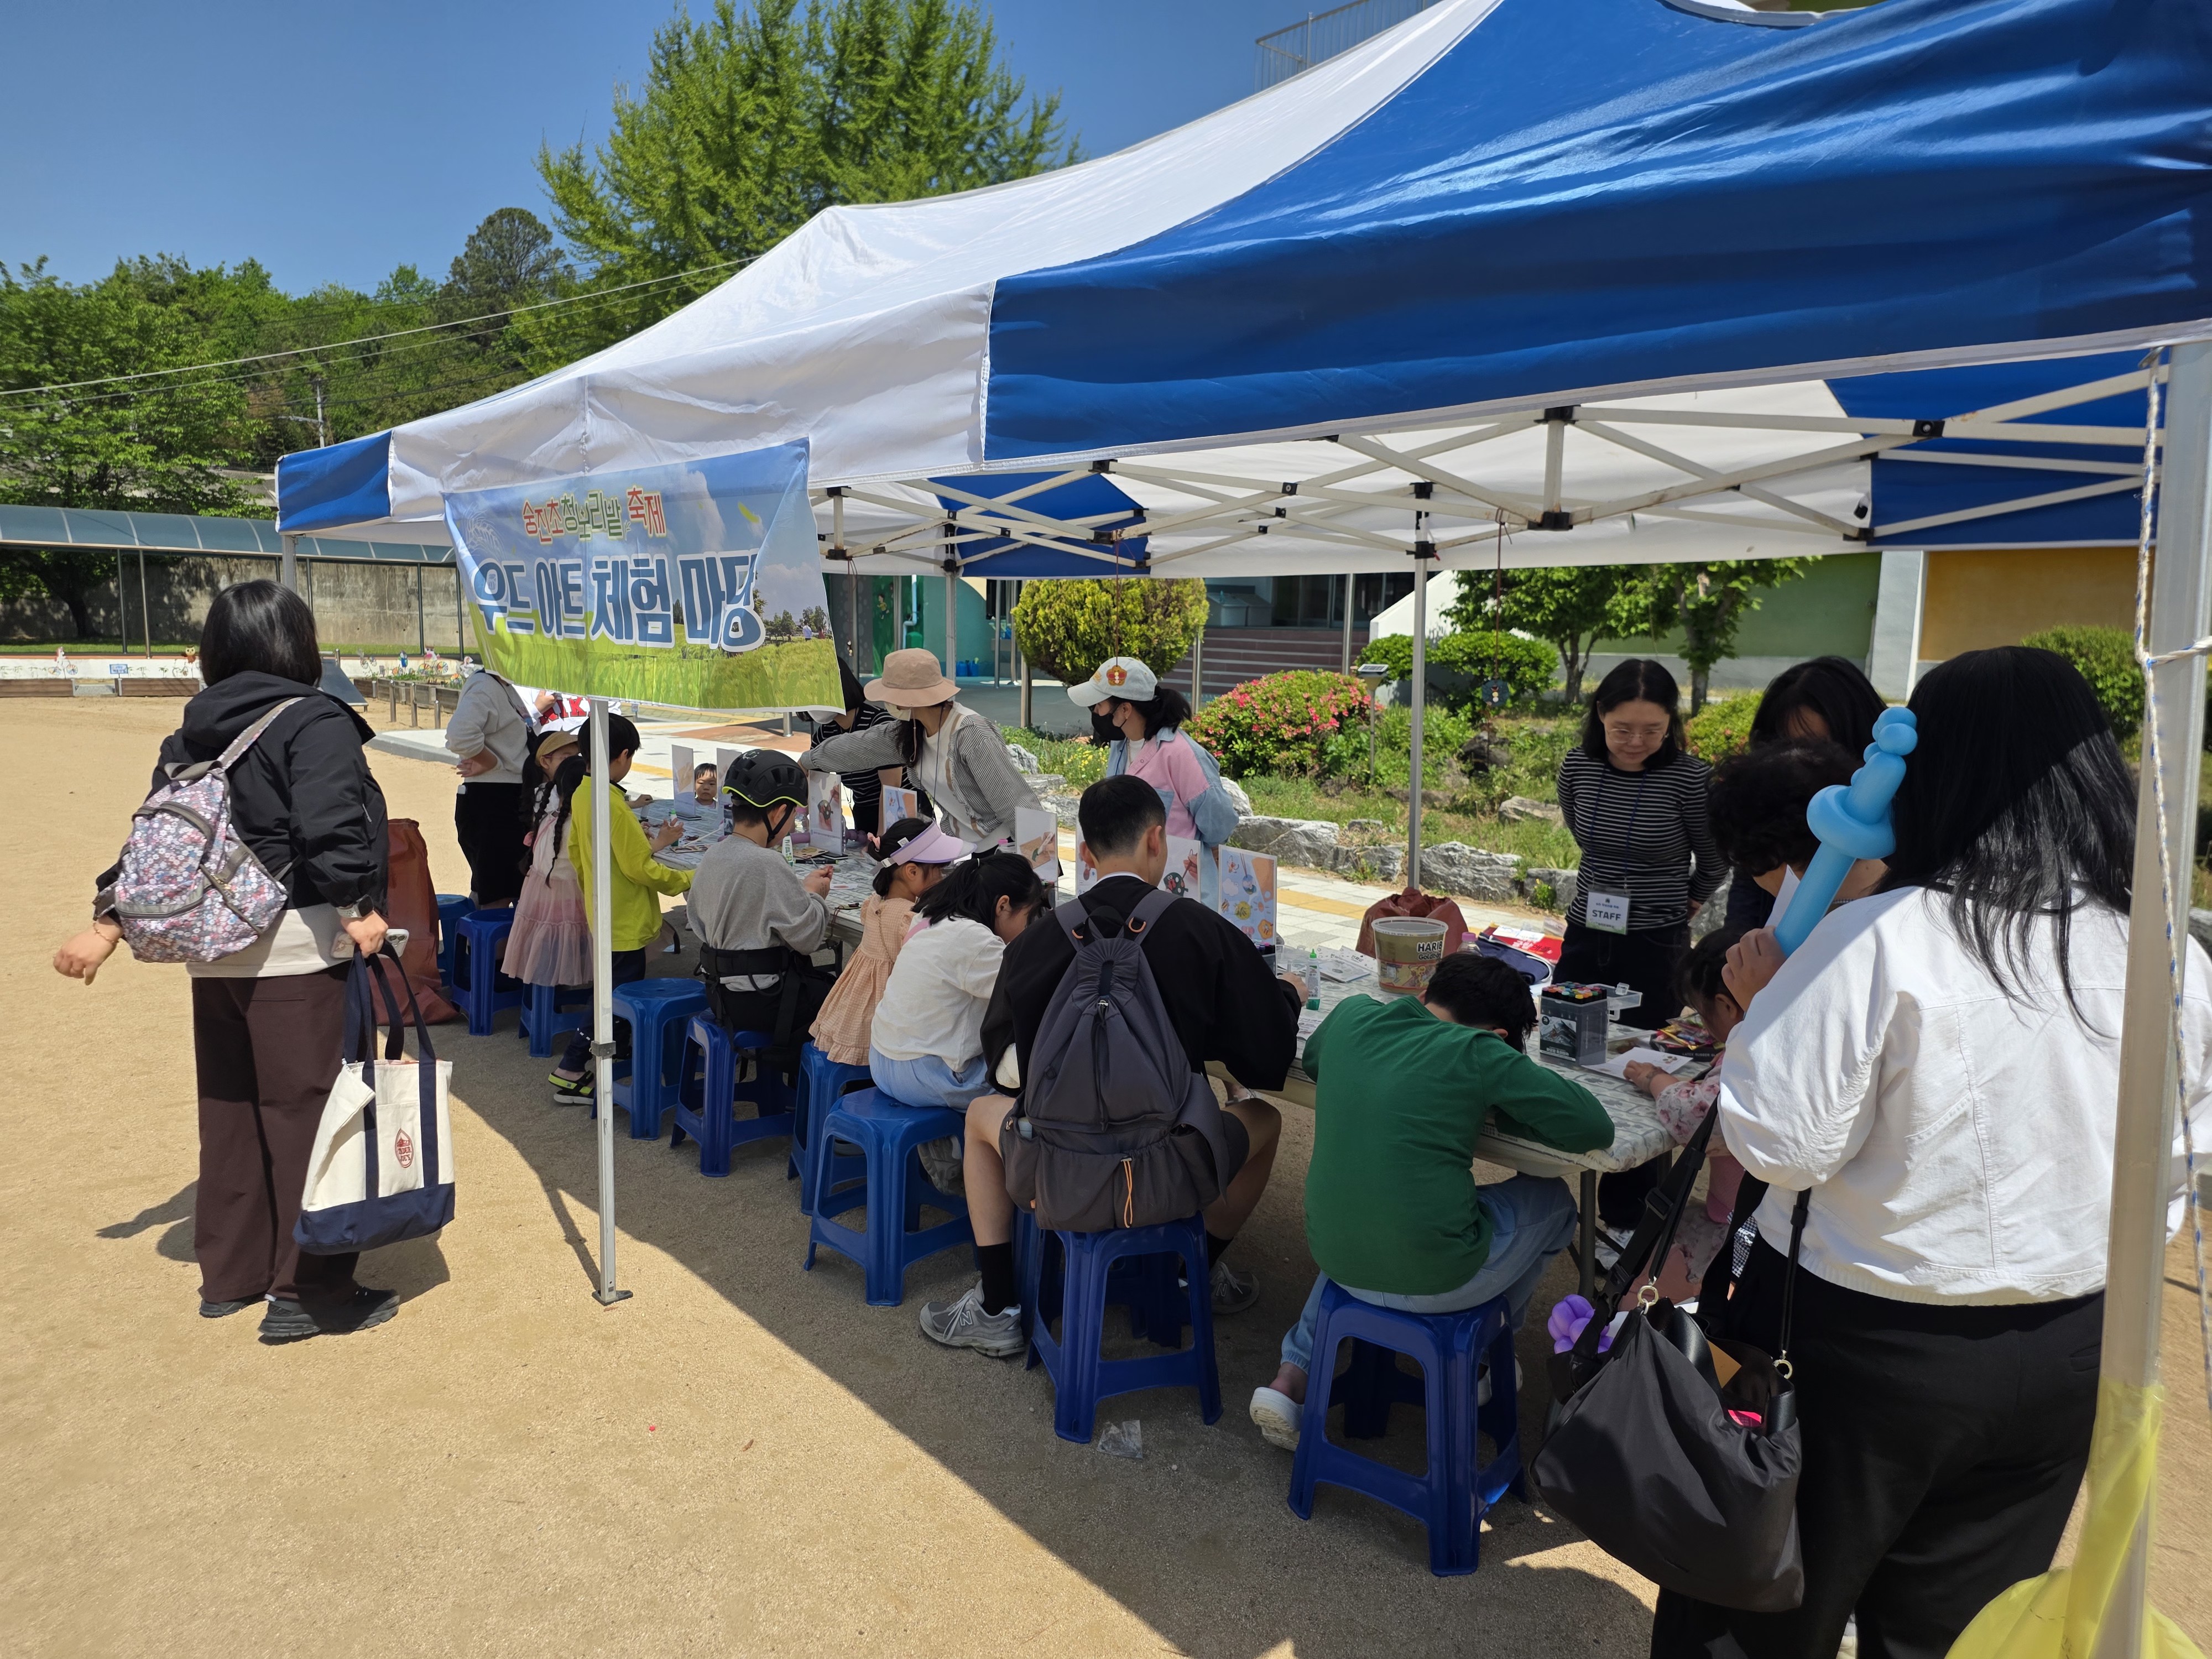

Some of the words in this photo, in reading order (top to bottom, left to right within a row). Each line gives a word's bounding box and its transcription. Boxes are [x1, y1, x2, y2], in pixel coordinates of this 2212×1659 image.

[626, 486, 666, 537] 축제
[472, 559, 535, 634] 우드
[534, 557, 586, 639] 아트
[589, 554, 675, 648] 체험
[677, 549, 765, 651] 마당
[1592, 909, 1621, 921] STAFF
[959, 1310, 973, 1326] N
